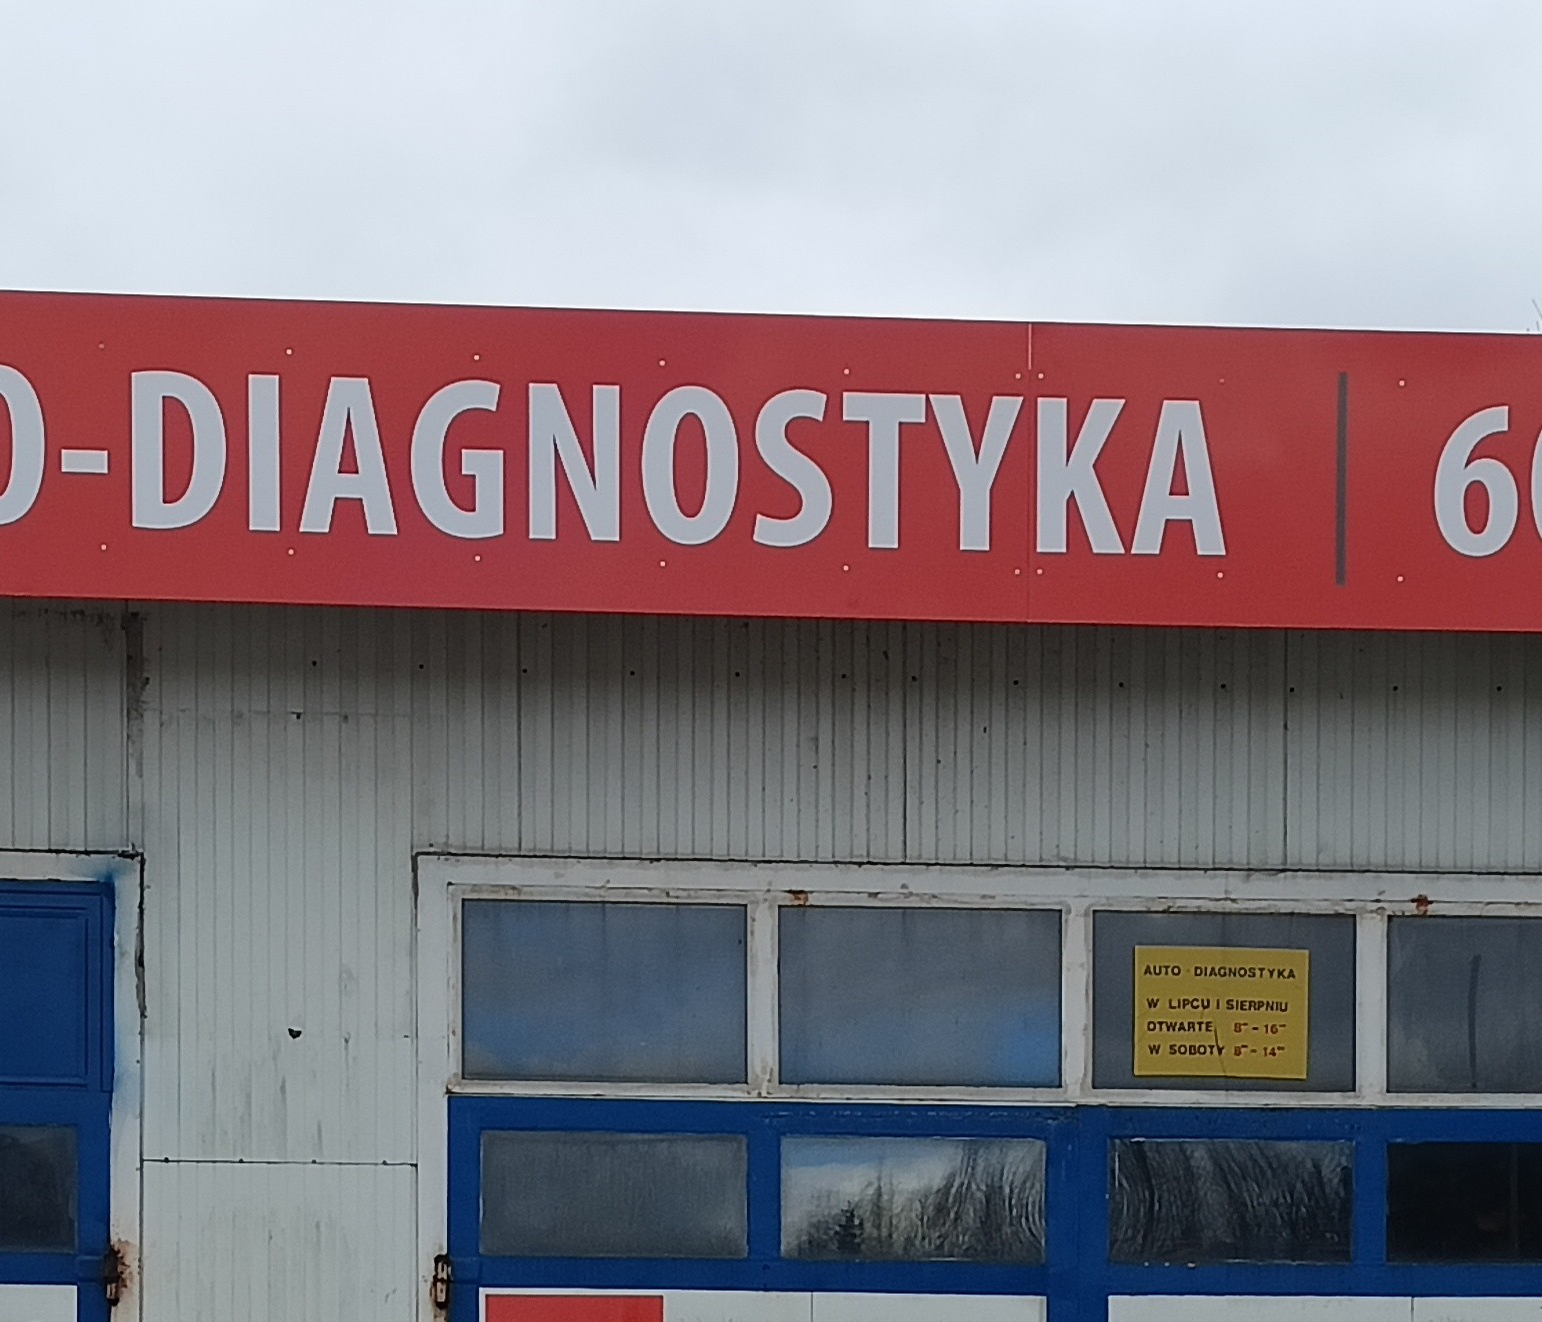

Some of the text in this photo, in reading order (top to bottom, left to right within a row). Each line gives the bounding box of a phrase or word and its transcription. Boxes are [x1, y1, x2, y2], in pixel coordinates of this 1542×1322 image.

[1144, 964, 1182, 977] AUTO
[1194, 965, 1296, 979] DIAGNOSTYKA
[1146, 997, 1289, 1013] W LIPCU I SIERPNIU
[1147, 1020, 1213, 1033] OTWARTE
[1148, 1043, 1161, 1056] W
[1169, 1043, 1225, 1056] SOBOTY
